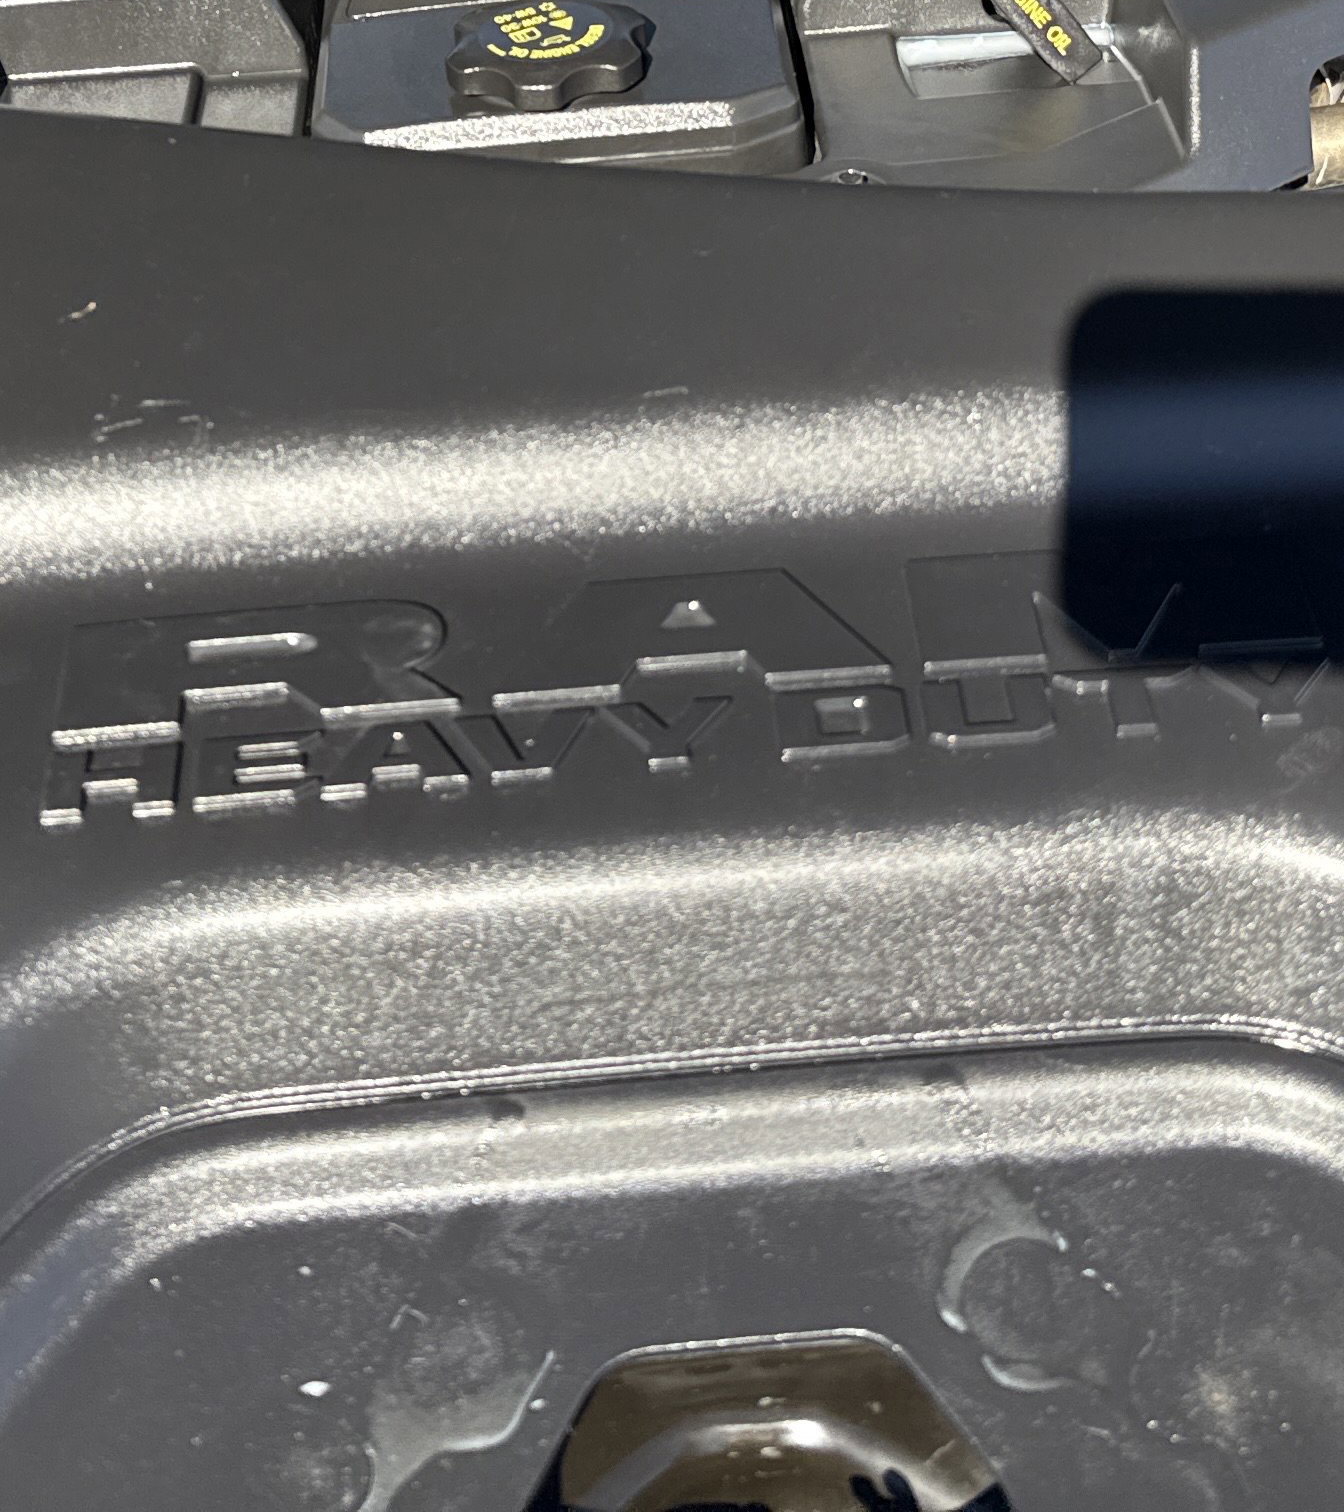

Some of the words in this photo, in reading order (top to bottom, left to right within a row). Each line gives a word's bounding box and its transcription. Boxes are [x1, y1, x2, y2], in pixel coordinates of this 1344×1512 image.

[1046, 25, 1072, 57] OIL
[48, 543, 1324, 746] RAM
[40, 694, 736, 826] HEAVY
[768, 653, 1330, 766] DUTY
